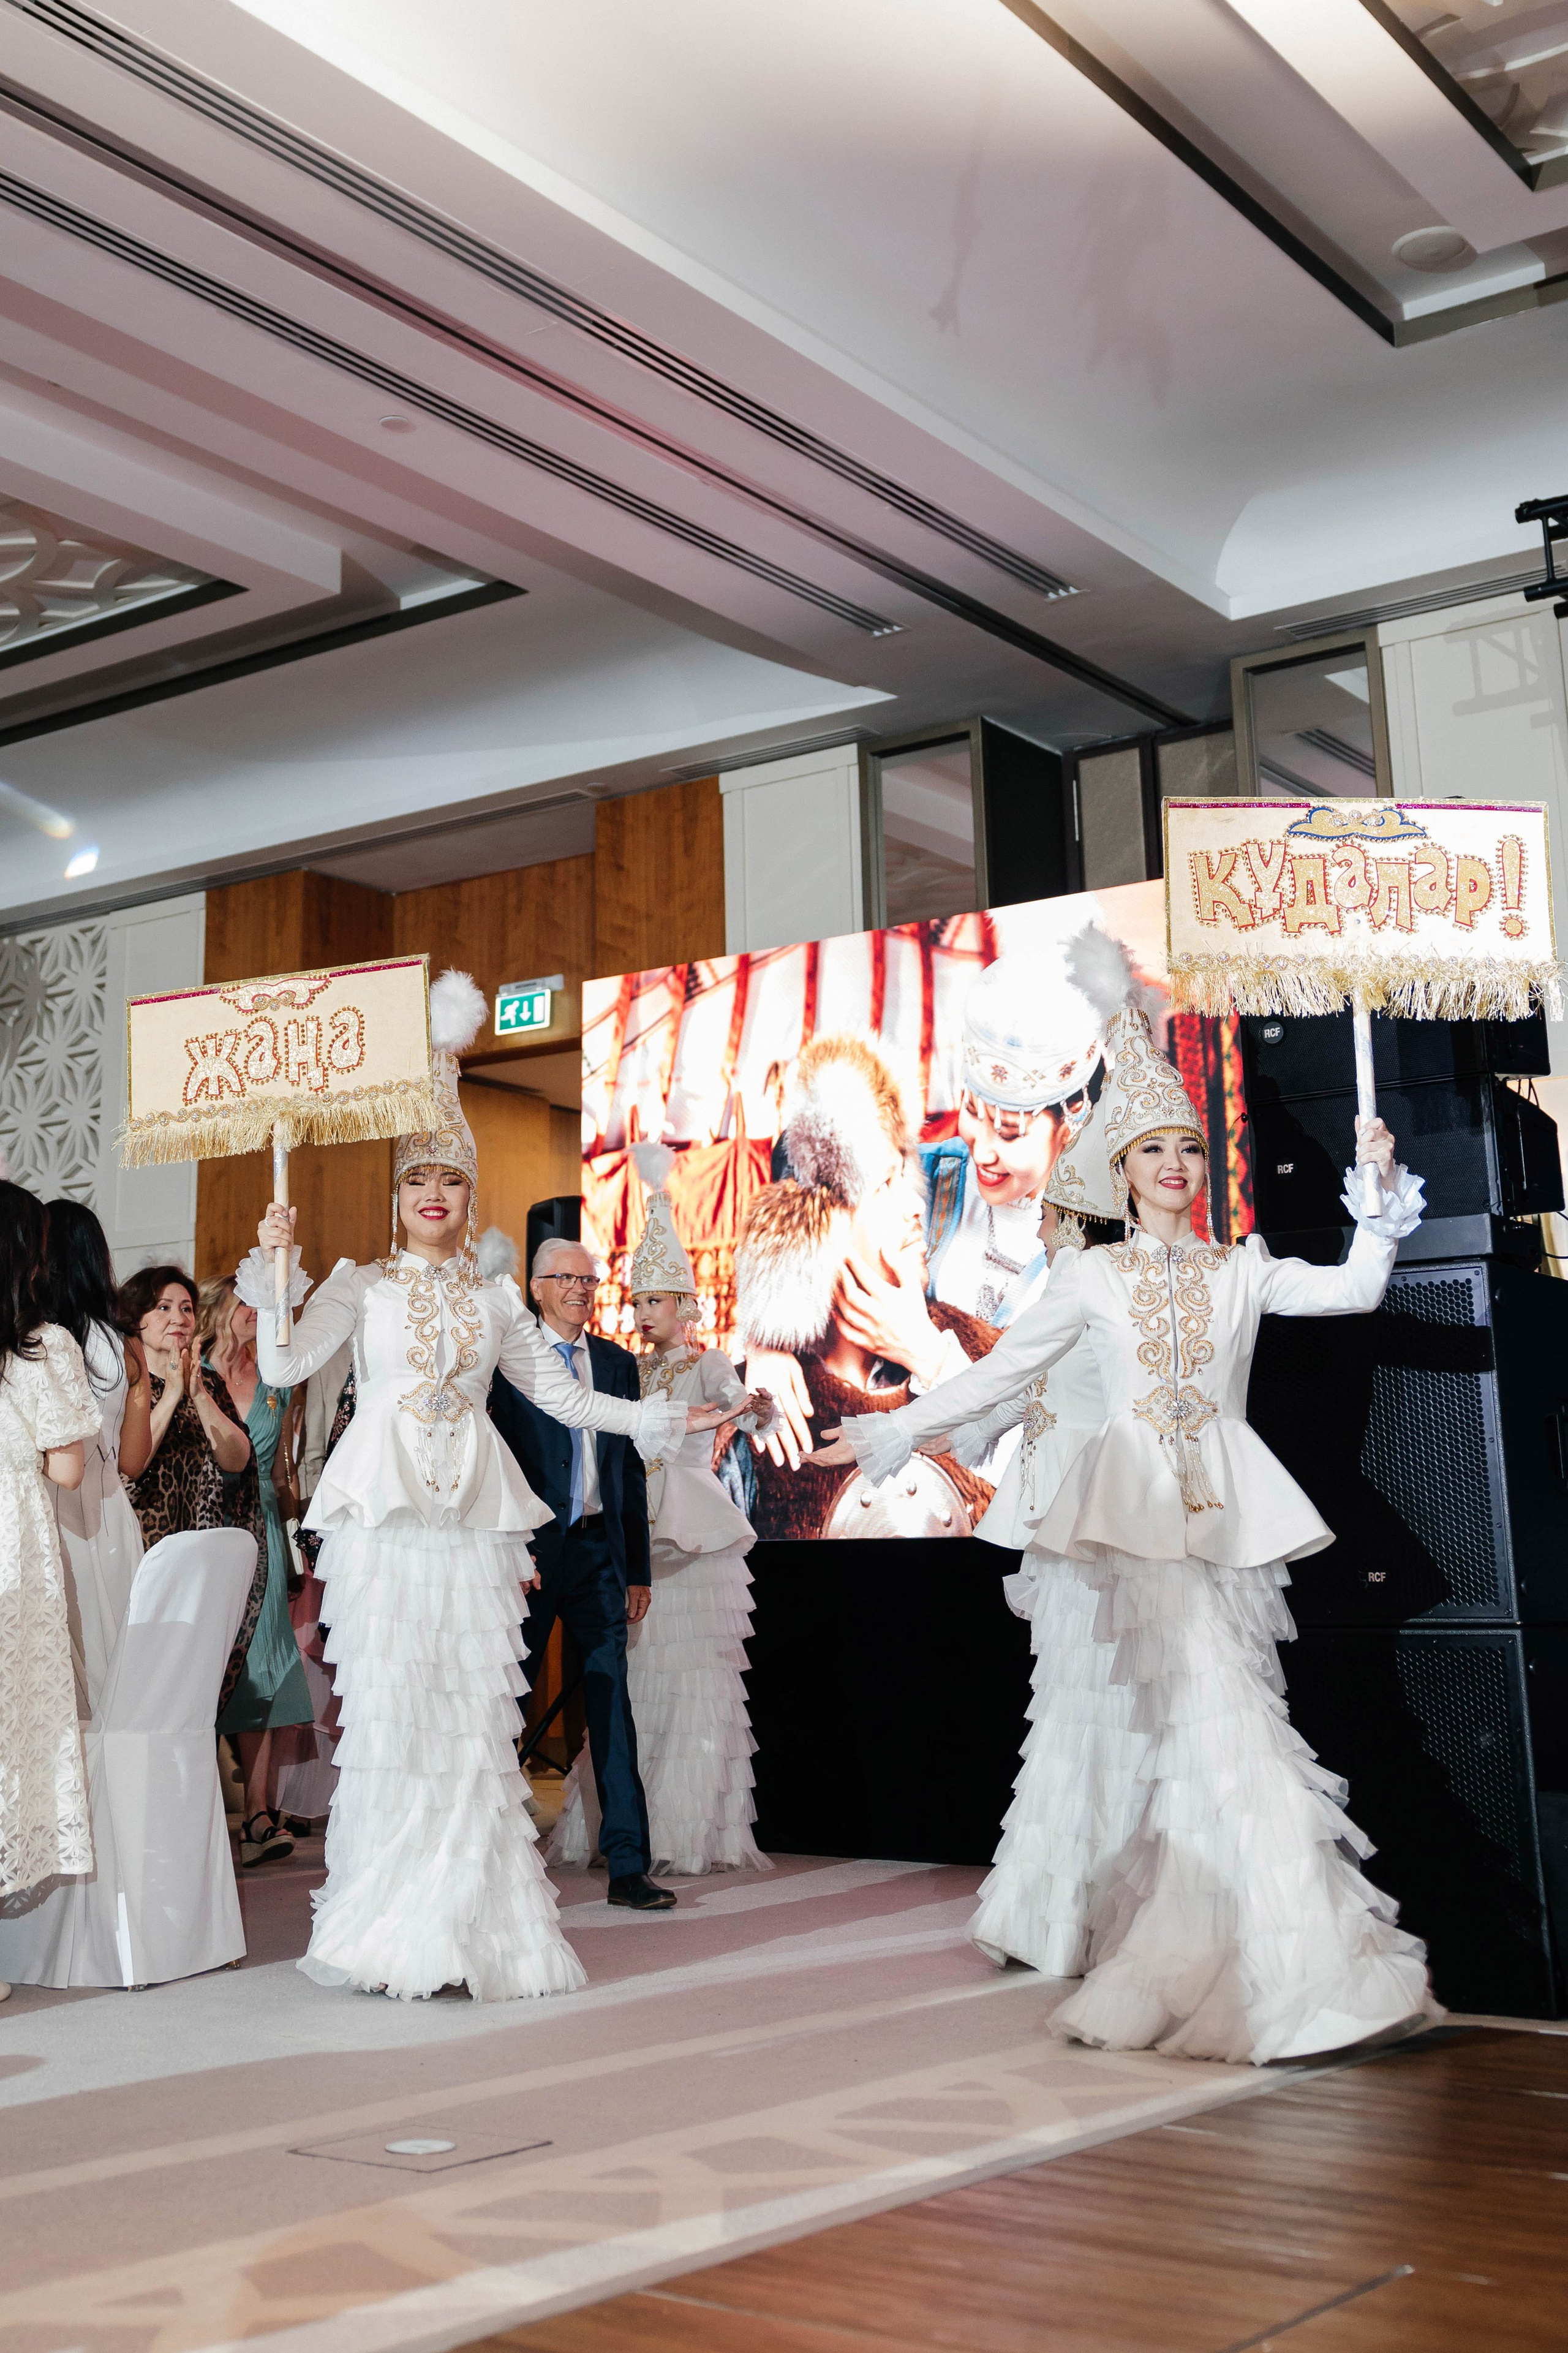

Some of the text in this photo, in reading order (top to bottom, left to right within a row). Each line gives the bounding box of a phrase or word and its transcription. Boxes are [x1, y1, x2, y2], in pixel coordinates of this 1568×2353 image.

[1264, 1027, 1281, 1038] RCF
[1277, 1163, 1294, 1174] RCF
[1368, 1571, 1386, 1582] RCF
